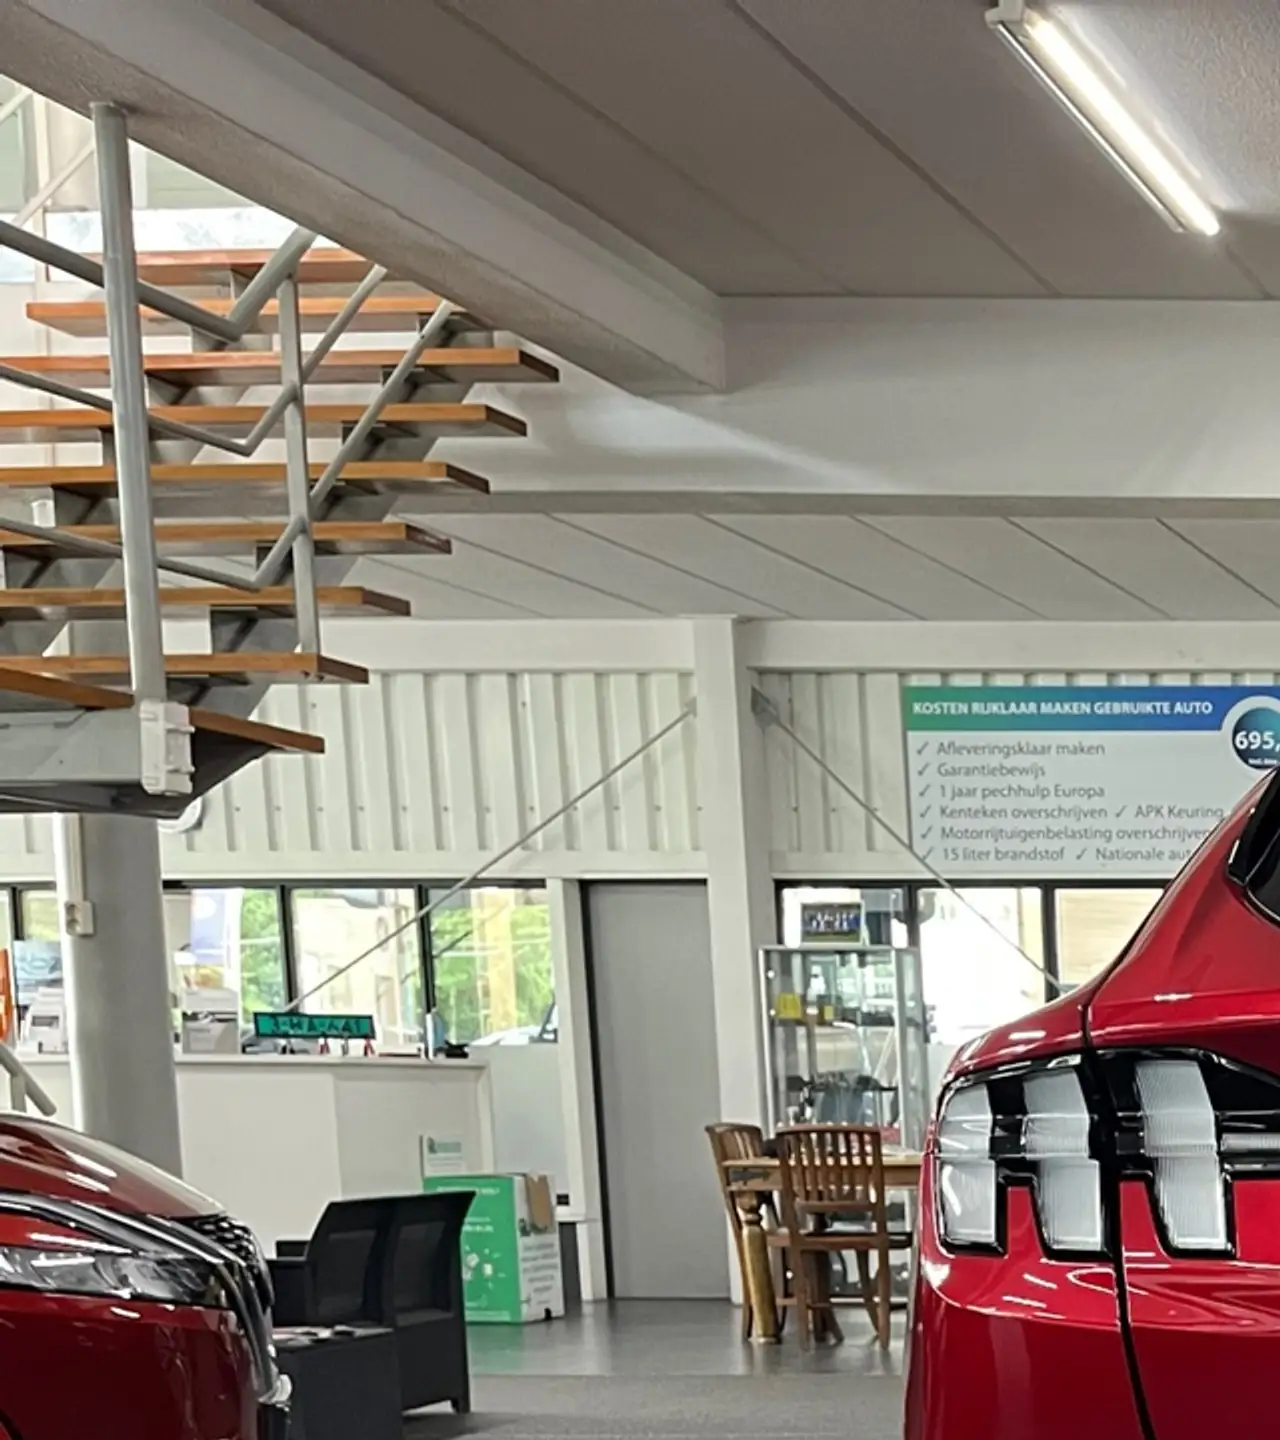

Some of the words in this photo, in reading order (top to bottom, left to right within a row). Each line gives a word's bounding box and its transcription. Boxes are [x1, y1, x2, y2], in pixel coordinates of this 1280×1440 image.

[913, 702, 968, 714] KOSTEN
[1040, 702, 1090, 714] MAKEN
[1094, 702, 1170, 714] GEBRUIKTE
[1174, 701, 1213, 714] AUTO
[936, 741, 1051, 759] Afleveringsklaar
[1056, 742, 1106, 755] maken
[937, 763, 1046, 779] Garantiebewijs
[951, 786, 977, 801] jaar
[982, 785, 1050, 801] pechhulp
[1054, 785, 1105, 801] Europa
[940, 806, 1008, 819] Kenteken
[1011, 806, 1107, 821] overschrijven
[1135, 806, 1164, 818] APK
[1168, 806, 1224, 821] Keuring
[941, 827, 1112, 843] Motorrijtuigenbelasting
[944, 849, 959, 861] 15
[962, 848, 990, 861] liter
[994, 847, 1064, 861] brandstof
[1096, 847, 1165, 861] Nationale
[1169, 848, 1192, 861] aut
